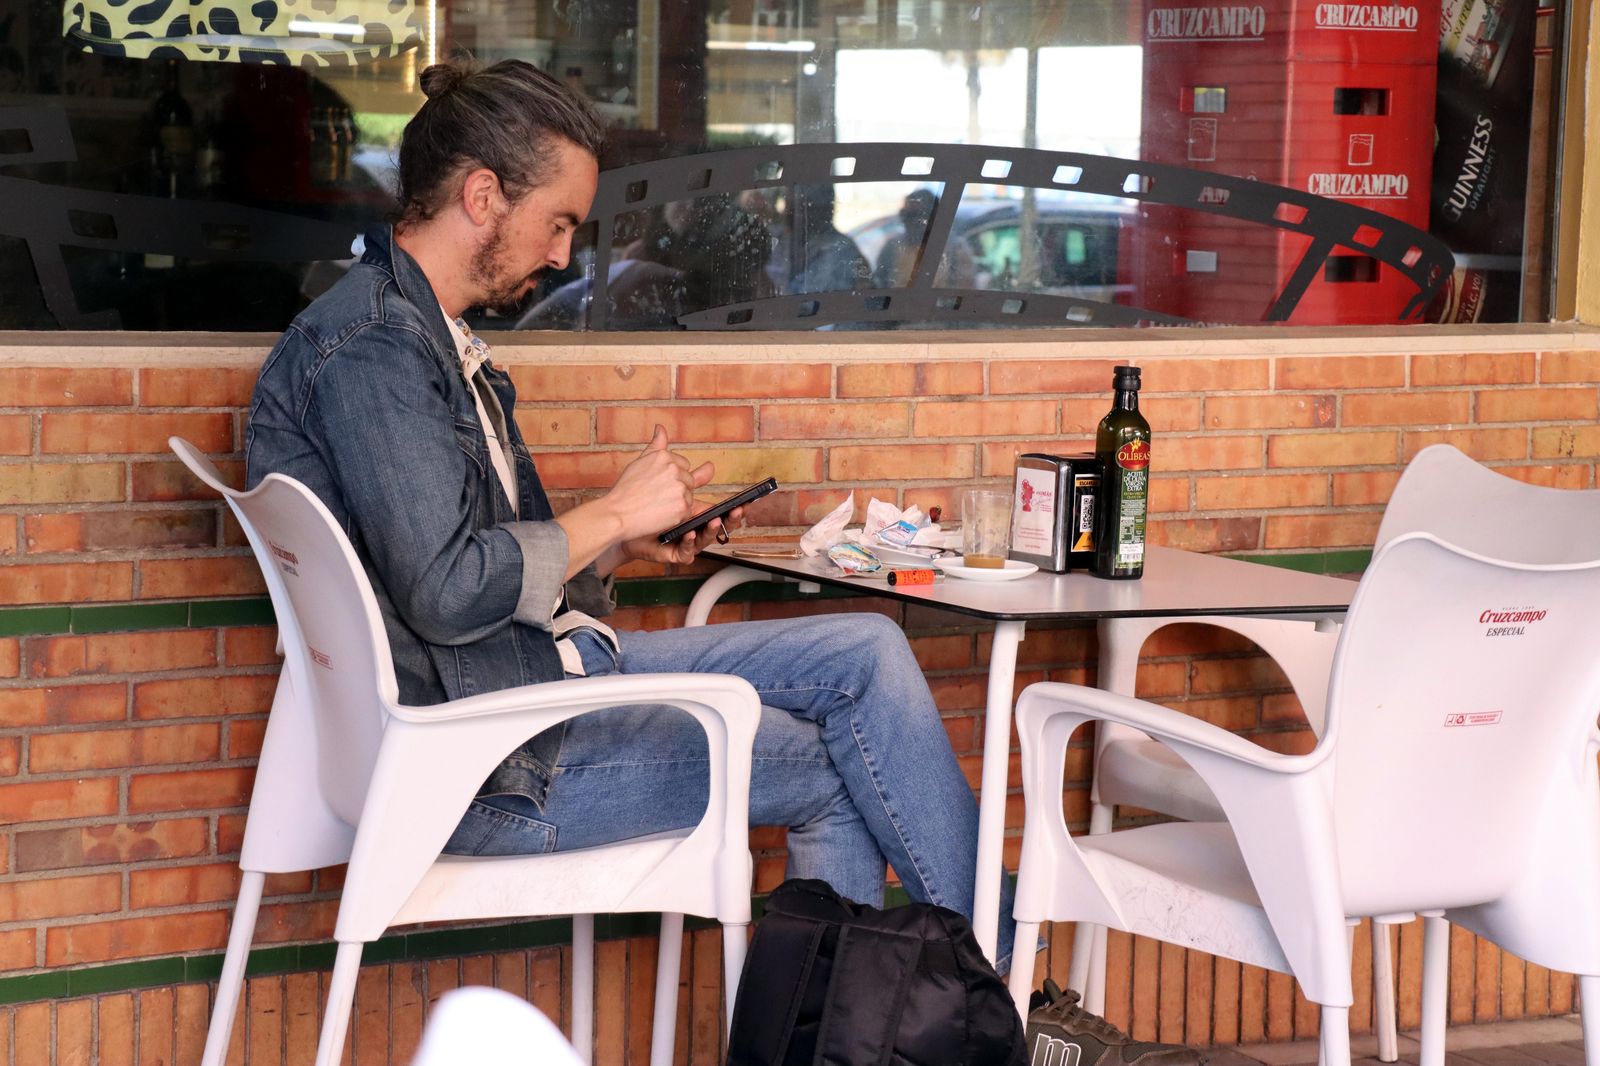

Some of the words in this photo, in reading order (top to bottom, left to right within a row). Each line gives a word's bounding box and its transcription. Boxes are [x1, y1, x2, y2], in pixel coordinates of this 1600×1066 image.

[1148, 6, 1265, 36] CRUZCAMPO
[1315, 4, 1418, 28] CRUZCAMPO
[1443, 114, 1492, 222] GUINNESS
[1307, 173, 1409, 195] CRUZCAMPO
[1479, 609, 1547, 624] Cruzcampo
[1486, 627, 1525, 637] ESPECIAL
